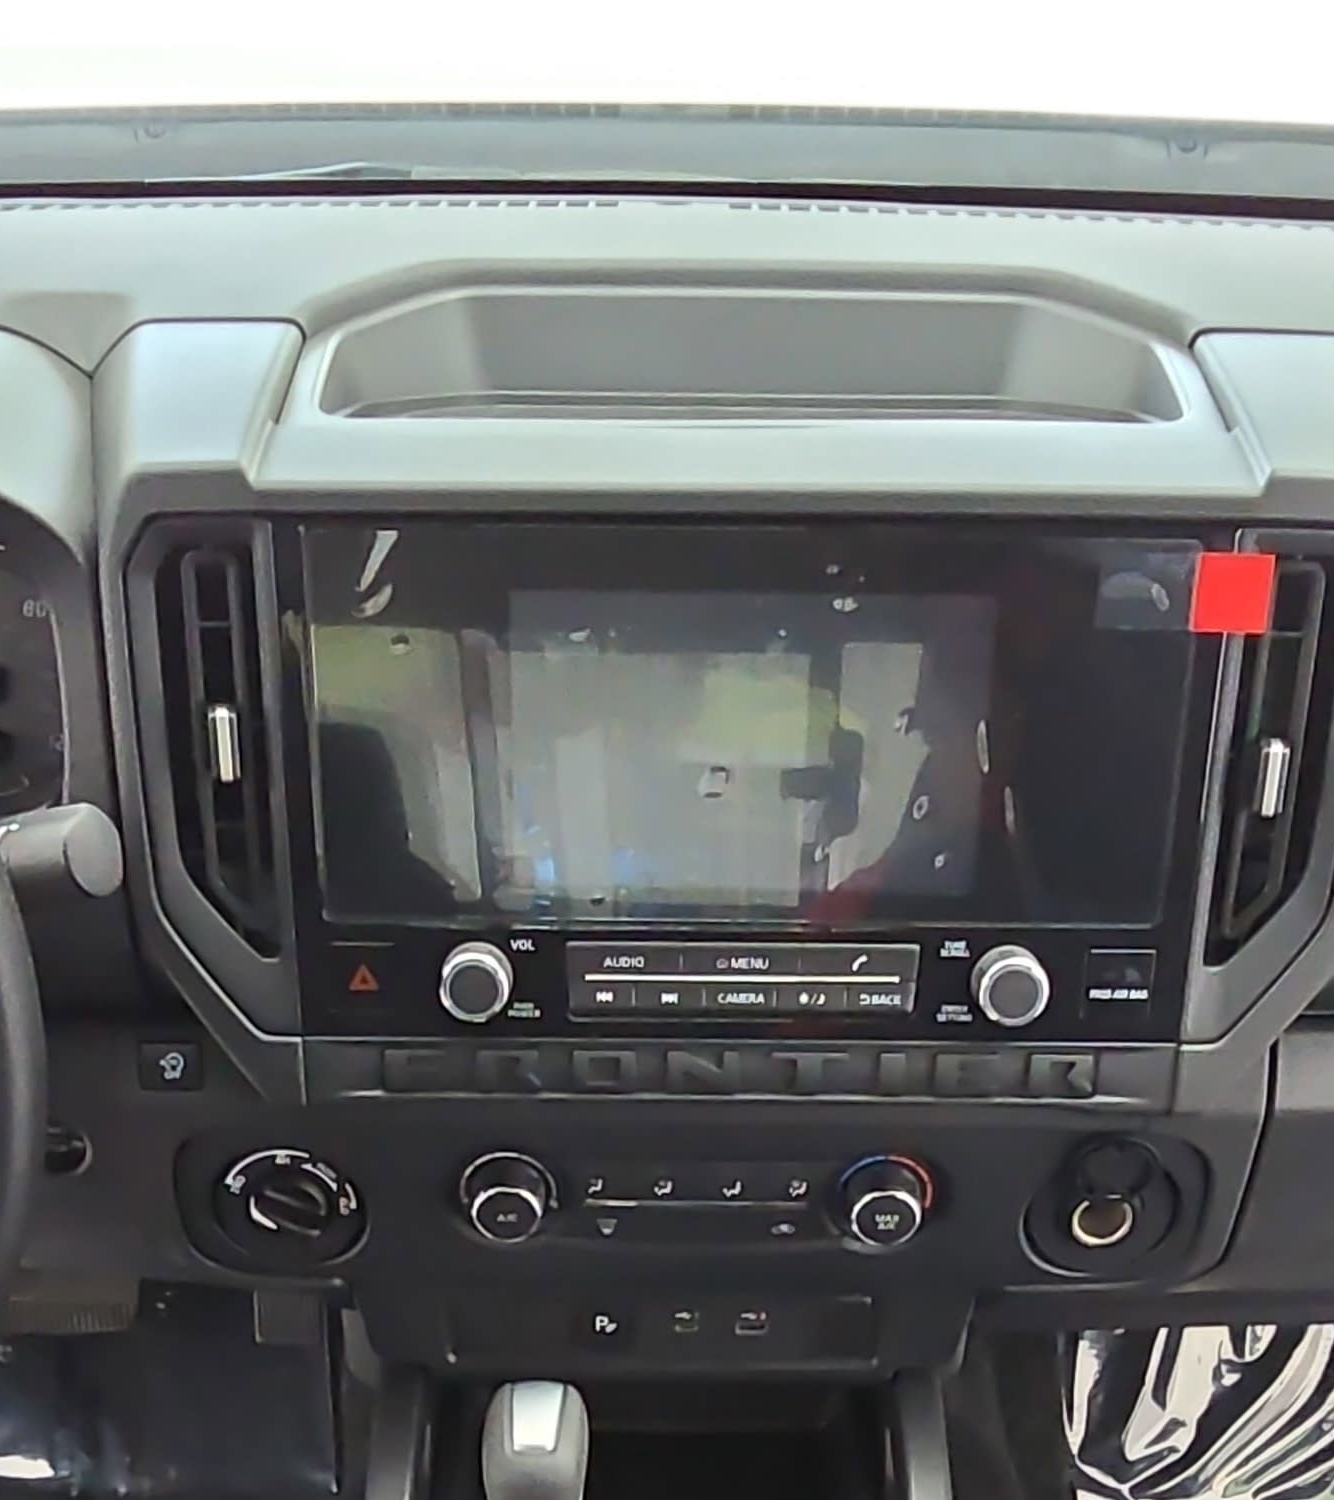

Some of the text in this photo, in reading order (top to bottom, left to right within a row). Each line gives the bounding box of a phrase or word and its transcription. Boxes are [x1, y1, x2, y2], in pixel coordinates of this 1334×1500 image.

[510, 938, 536, 951] VOL
[603, 956, 645, 968] AUDIO
[730, 957, 770, 970] MENU
[717, 992, 765, 1005] CAMERA
[871, 994, 903, 1006] BACK
